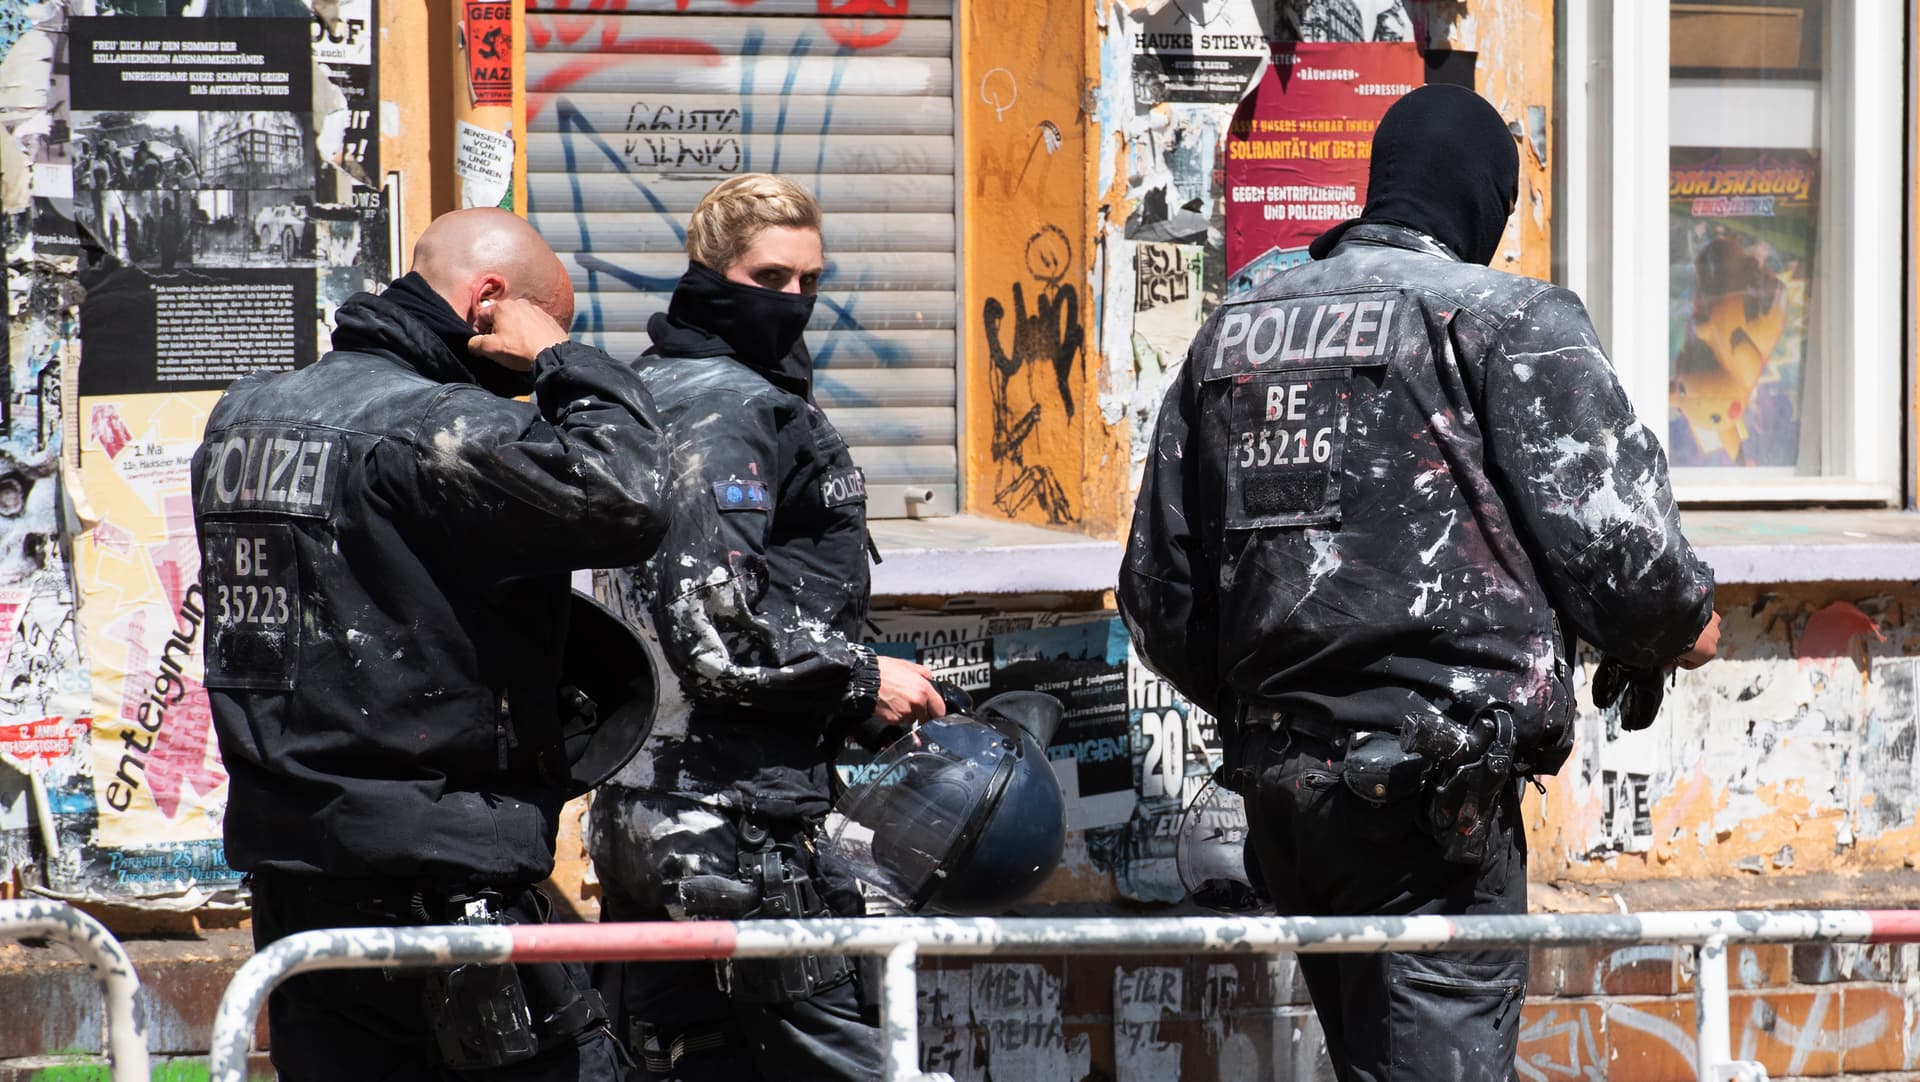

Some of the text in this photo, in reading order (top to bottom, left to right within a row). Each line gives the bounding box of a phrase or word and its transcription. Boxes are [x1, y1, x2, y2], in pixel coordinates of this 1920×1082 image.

[119, 41, 142, 51] DICH
[142, 41, 161, 51] AUF
[161, 42, 180, 51] DEN
[181, 41, 220, 51] SOMMER
[220, 42, 237, 51] DER
[1135, 33, 1193, 49] HAUKE
[121, 71, 289, 82] UNREGIERBARE KIEZE SCHAFFEN GEGEN
[190, 84, 290, 95] DAS AUTORITÄTS-VIRUS
[1260, 120, 1297, 132] UNSERE
[463, 127, 507, 148] JENSEITS
[473, 139, 496, 151] VON
[462, 144, 502, 163] NELKEN
[1230, 137, 1308, 160] SOLIDARITÄT
[1309, 140, 1332, 160] MIT
[1333, 140, 1355, 160] DER
[457, 158, 502, 180] PRALINEN
[468, 155, 491, 167] UND
[1669, 168, 1811, 199] FARBENSCHOC
[1232, 186, 1356, 202] GEGEN GENTRIFIZIERUNG
[1264, 205, 1286, 220] UND
[1213, 300, 1395, 369] POLIZEI
[1266, 384, 1308, 421] BE
[1240, 427, 1332, 468] 35216
[200, 437, 332, 505] POLIZEI
[235, 538, 269, 577] BE
[218, 585, 289, 624] 35223
[1073, 677, 1083, 686] of
[106, 572, 204, 812] enteignun
[173, 850, 193, 868] 25
